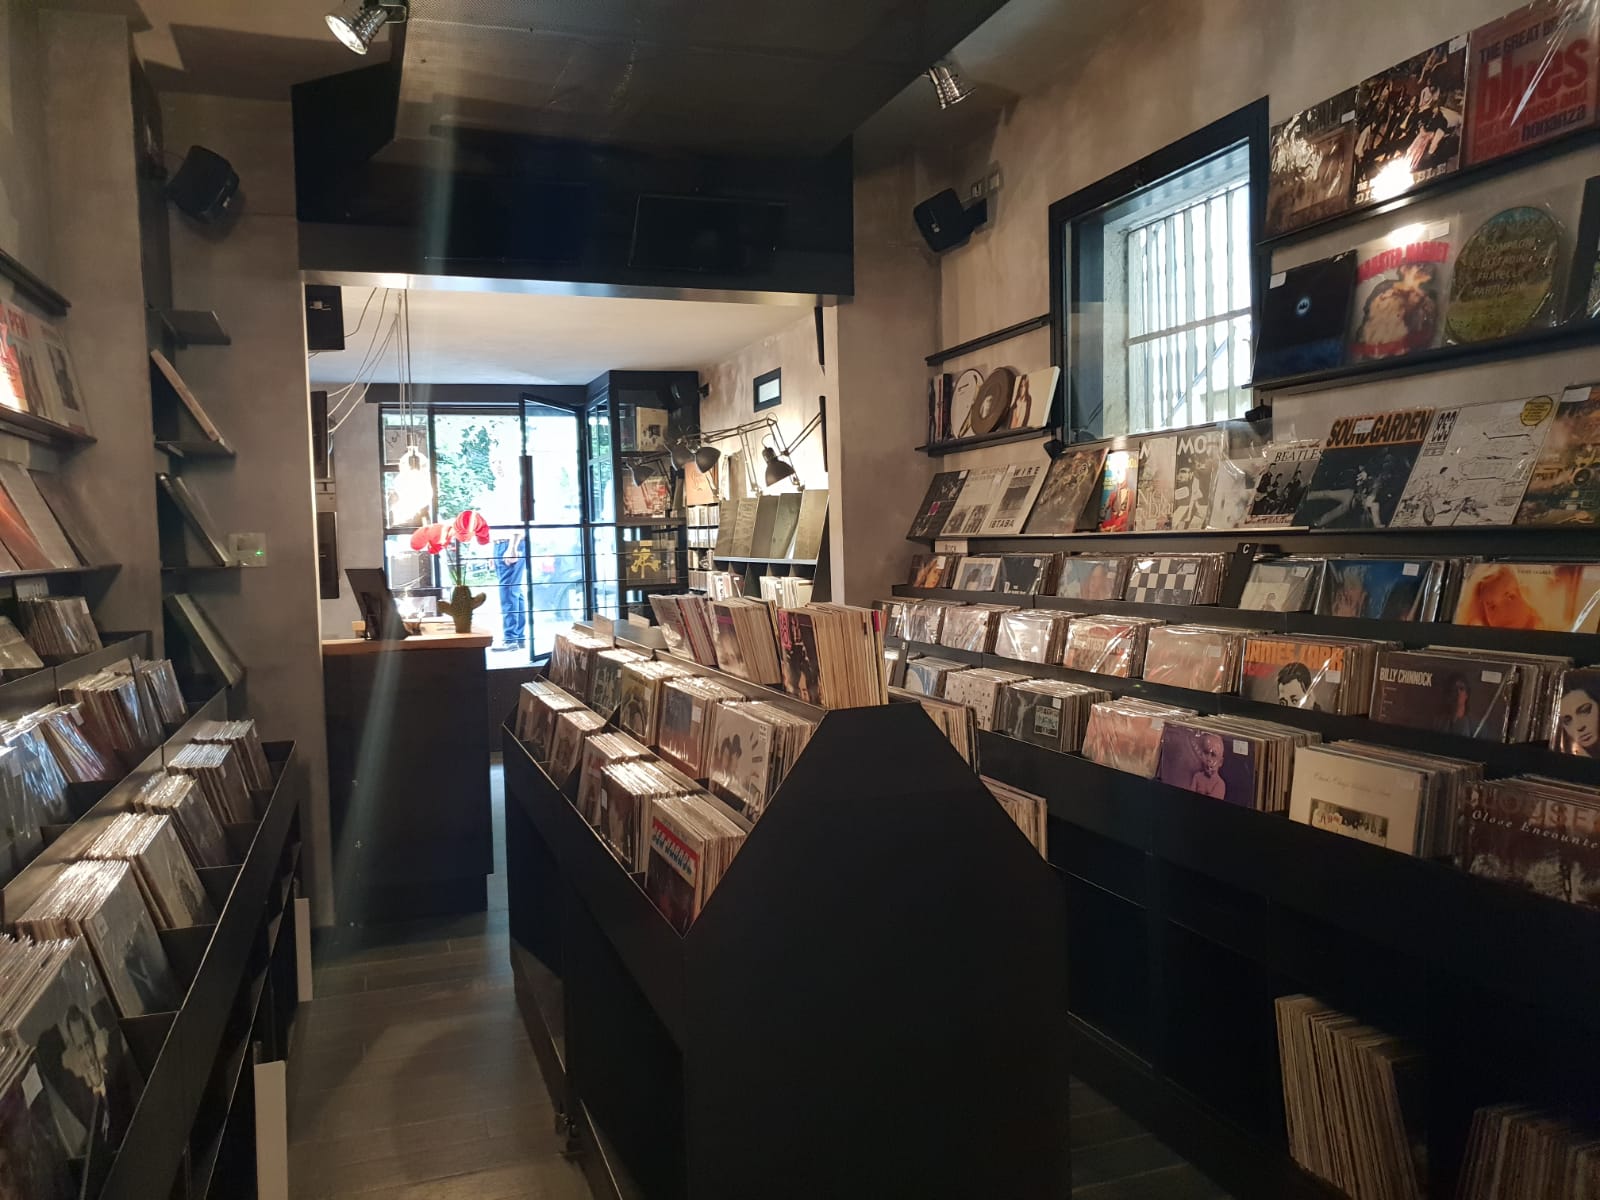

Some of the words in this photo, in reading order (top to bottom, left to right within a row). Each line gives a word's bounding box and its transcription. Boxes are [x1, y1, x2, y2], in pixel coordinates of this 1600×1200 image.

[1013, 465, 1041, 477] WIRE
[1242, 543, 1250, 553] C
[1379, 665, 1398, 682] BILLY
[1472, 809, 1513, 829] Close
